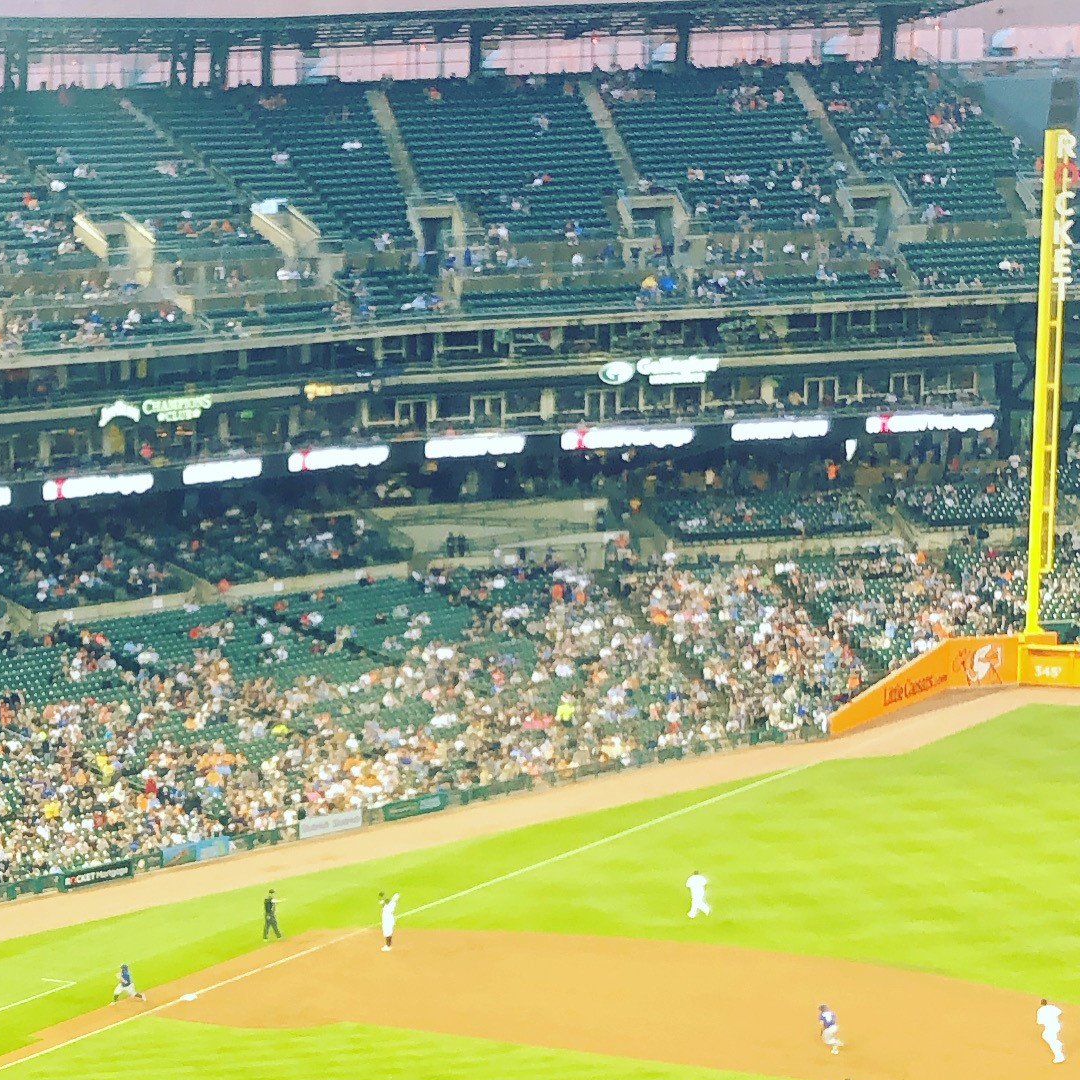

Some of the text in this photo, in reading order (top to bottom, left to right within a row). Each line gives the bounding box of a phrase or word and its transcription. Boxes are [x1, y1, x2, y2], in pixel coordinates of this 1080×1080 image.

[1051, 133, 1080, 301] ROCKET
[142, 394, 212, 415] CHAMPIONS
[64, 871, 96, 886] ROCKET
